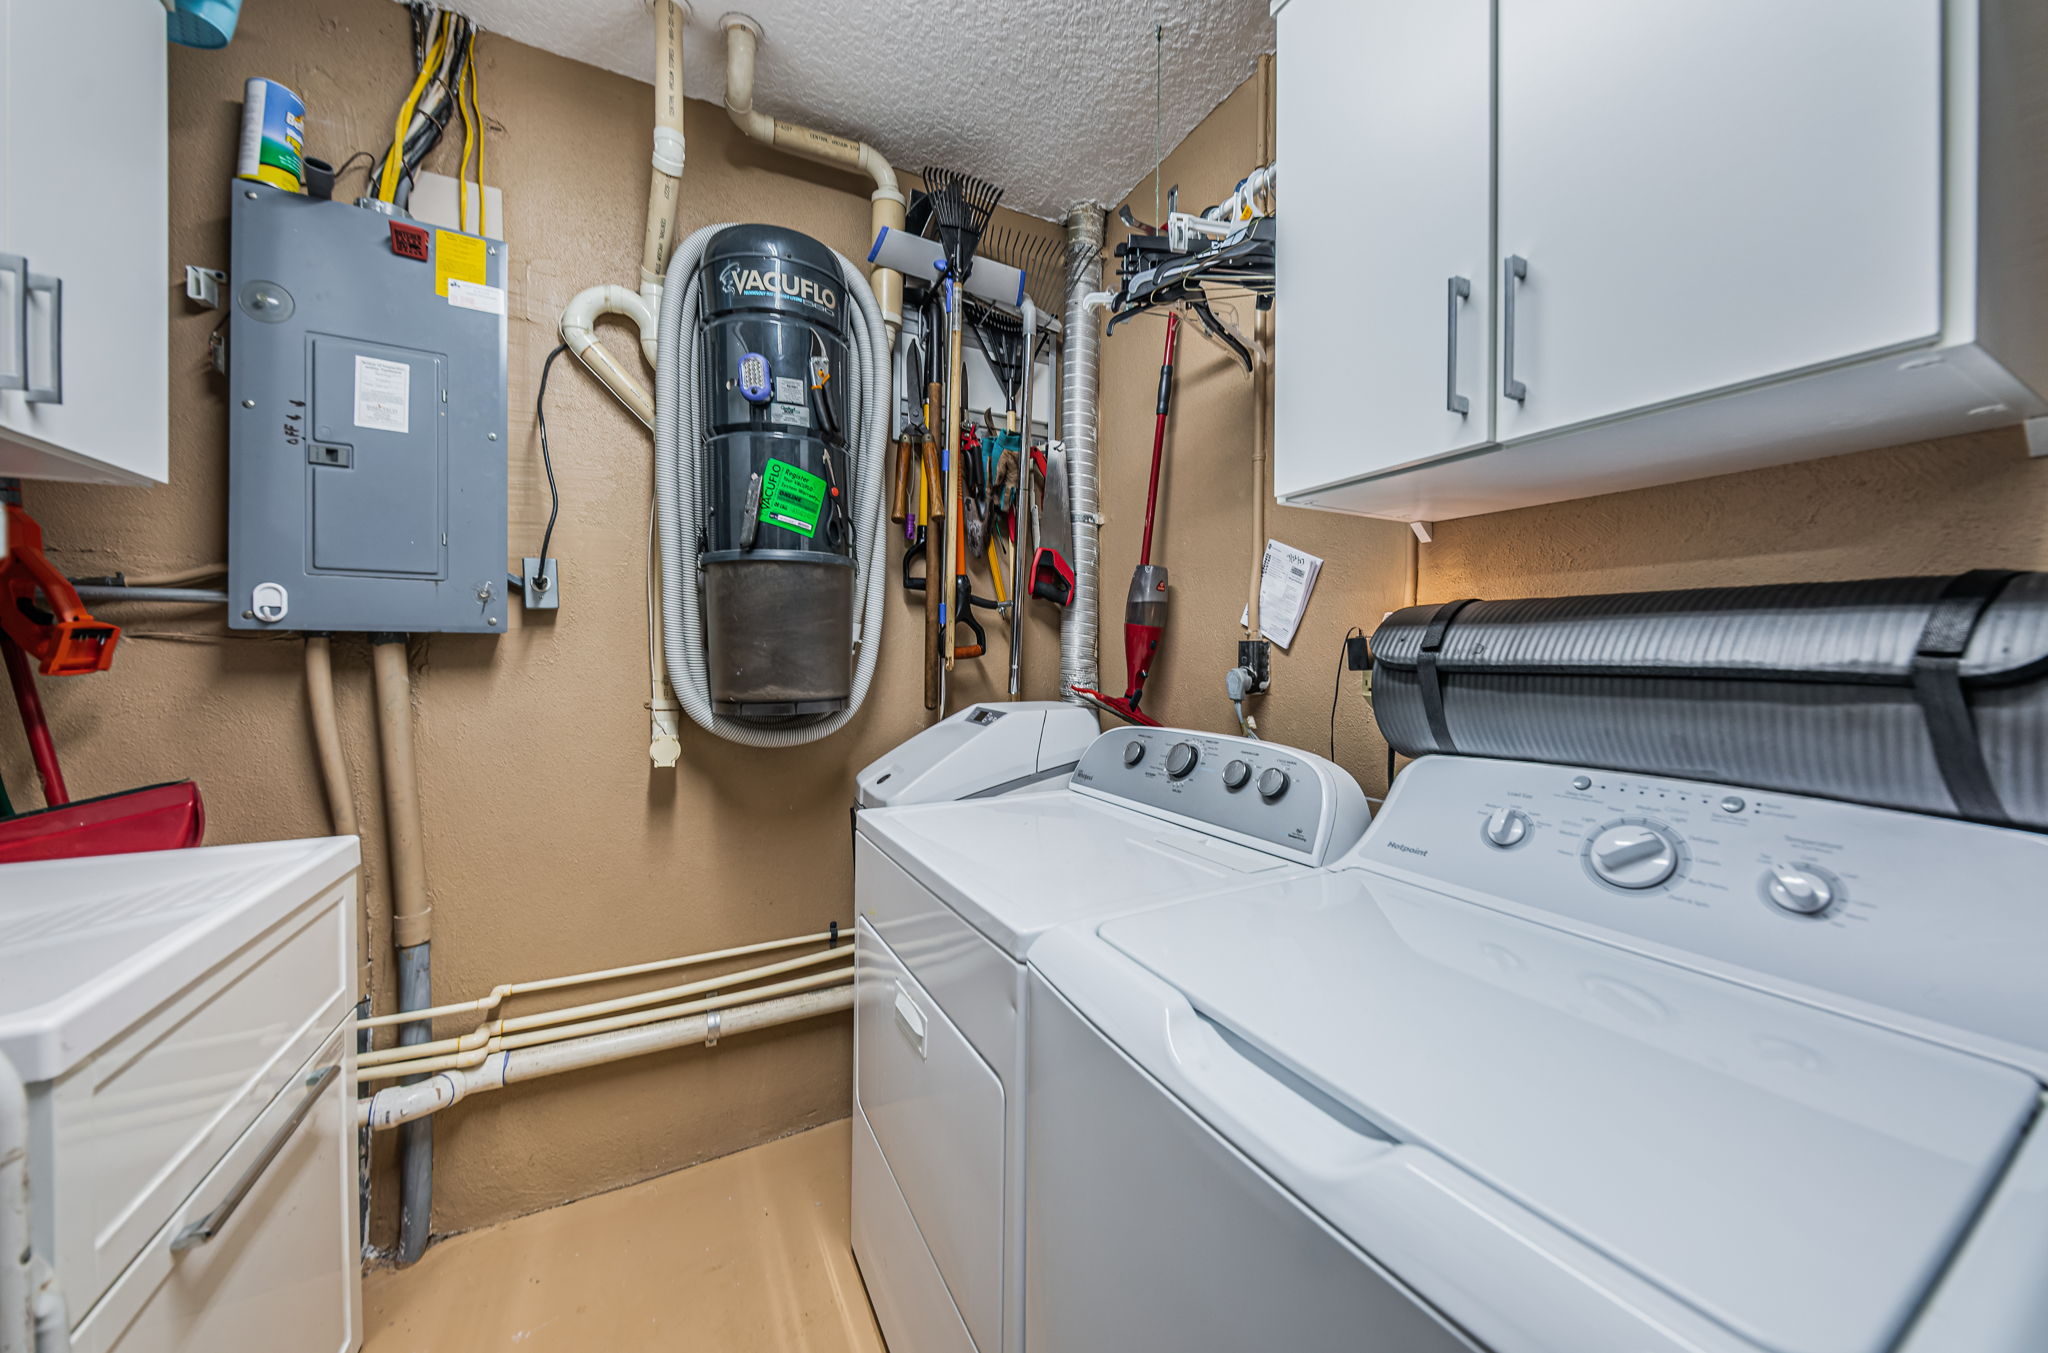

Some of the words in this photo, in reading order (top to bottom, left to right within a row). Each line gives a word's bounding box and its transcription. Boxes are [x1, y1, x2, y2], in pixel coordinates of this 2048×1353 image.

[732, 270, 835, 310] VACUFLO
[760, 464, 780, 509] VACUFLO
[785, 469, 809, 482] Register
[1387, 841, 1428, 857] Hotpoint
